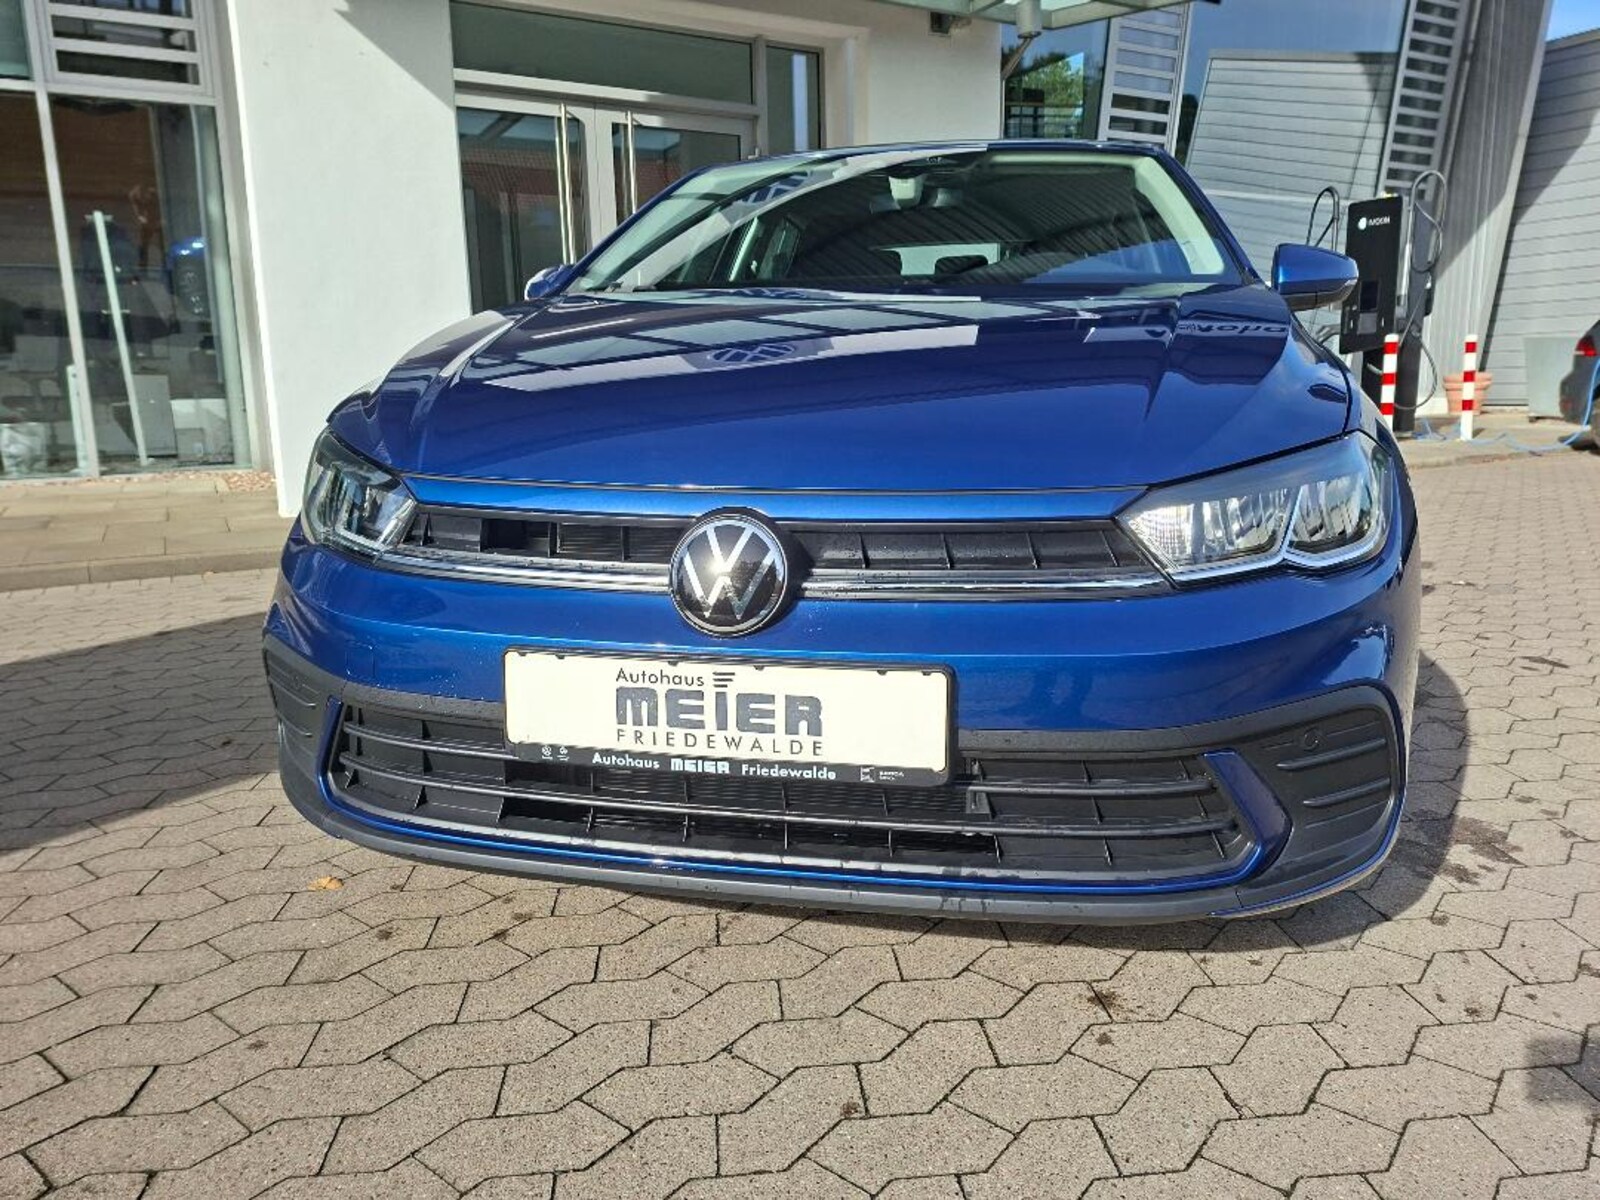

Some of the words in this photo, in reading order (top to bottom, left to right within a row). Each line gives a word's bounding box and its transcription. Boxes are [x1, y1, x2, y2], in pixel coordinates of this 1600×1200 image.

[616, 668, 704, 686] Autohaus
[616, 686, 823, 736] MEIER
[617, 728, 822, 756] FRIEDEWALDE
[592, 752, 660, 769] Autohaus
[671, 758, 730, 774] MEIER
[742, 764, 837, 780] Friedewalde
